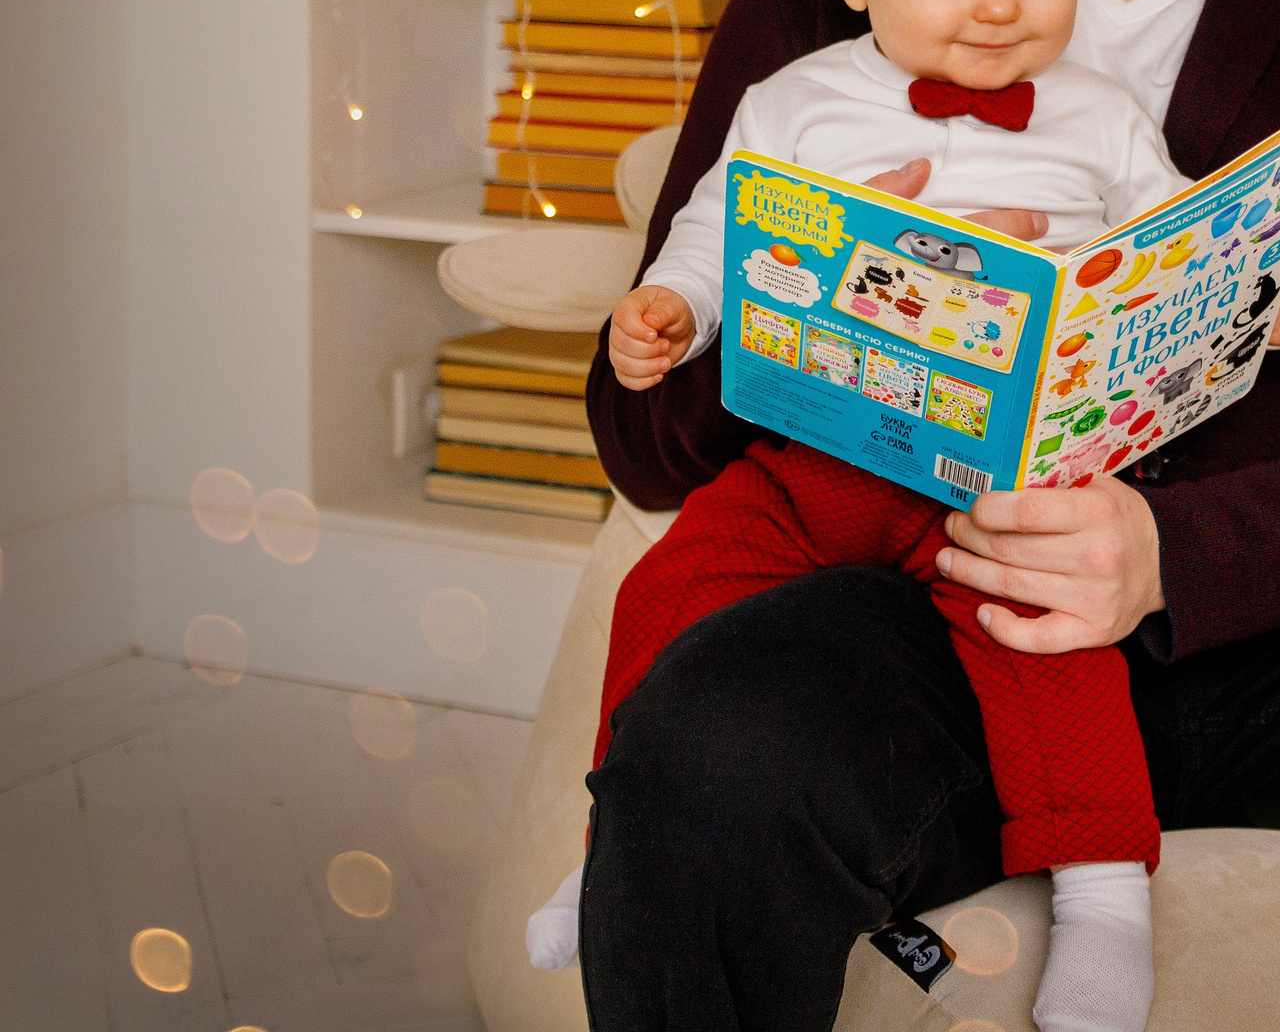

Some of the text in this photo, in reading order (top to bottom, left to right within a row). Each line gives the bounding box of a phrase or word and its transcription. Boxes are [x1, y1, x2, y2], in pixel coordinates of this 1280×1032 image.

[754, 182, 829, 216] ИЗУЧАЕМ
[1142, 171, 1269, 243] ОБУЧАЮЩИЕ ОКОШКИ
[1207, 231, 1234, 249] Голубой
[760, 259, 808, 281] Развиваем:
[765, 268, 805, 286] моторику
[764, 274, 810, 294] мышление
[764, 280, 802, 298] кругозор
[1115, 253, 1248, 340] ИЗУЧАЕМ
[1060, 309, 1107, 333] Оранжевый
[806, 314, 851, 336] СОБЕРИ
[854, 330, 881, 346] ВСЮ
[885, 342, 931, 364] СЕРИЮ!
[936, 377, 968, 392] СКОЛЬКО
[968, 389, 987, 399] БУКВ
[880, 413, 912, 433] БУКВА
[888, 436, 913, 452] SIMA
[1067, 432, 1097, 450] Розовый
[1130, 425, 1156, 444] Красный
[887, 441, 914, 454] LAND
